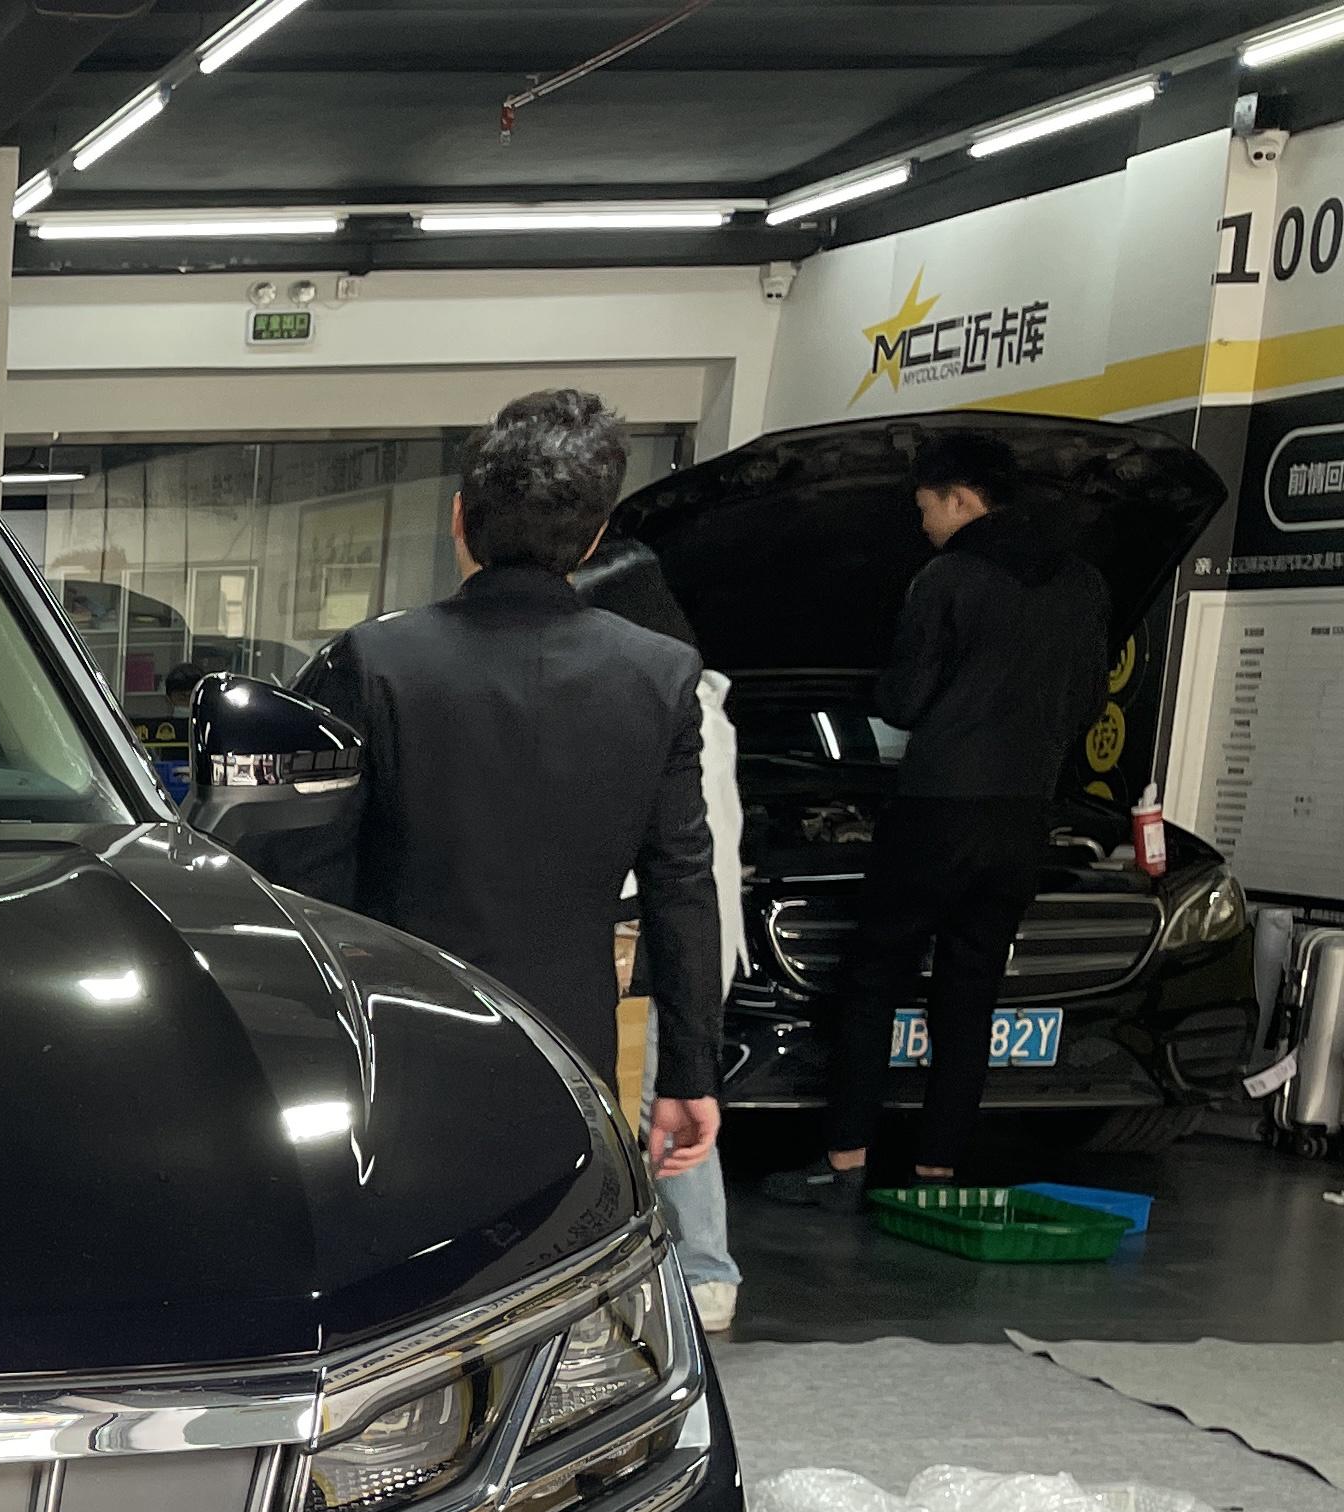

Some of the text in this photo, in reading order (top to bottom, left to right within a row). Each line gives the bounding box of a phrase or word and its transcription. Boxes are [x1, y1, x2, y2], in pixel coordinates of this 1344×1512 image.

[872, 300, 1049, 375] MCC 迈卡库
